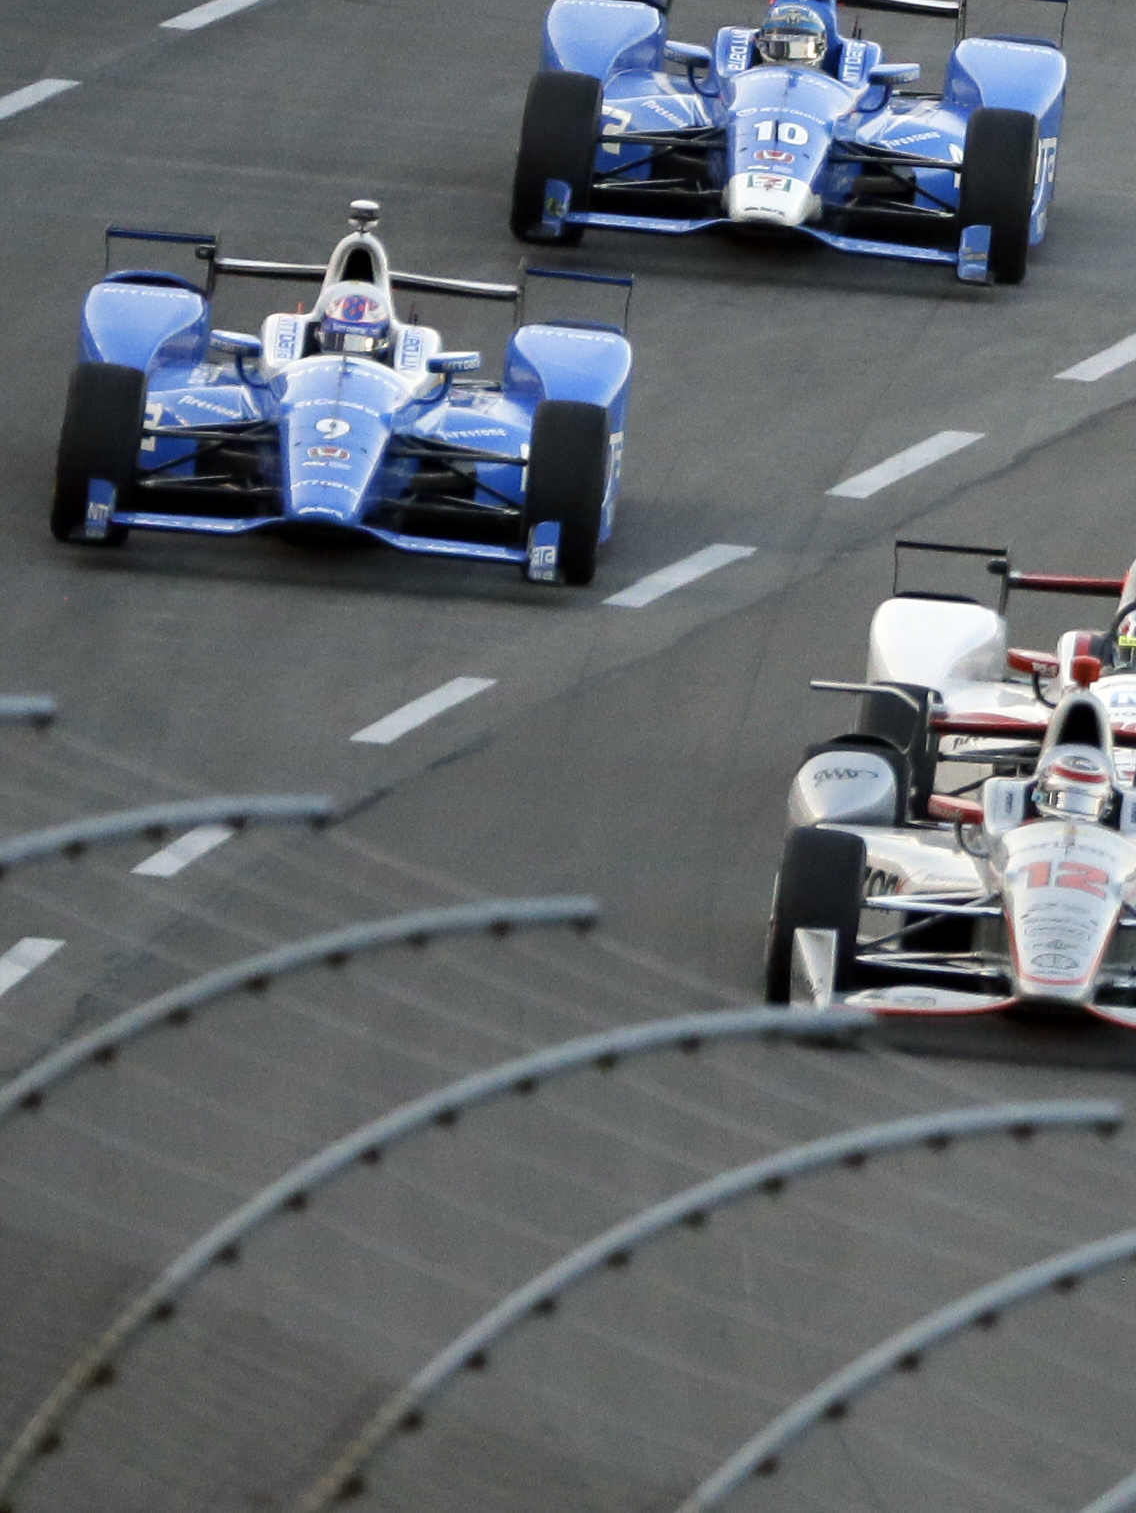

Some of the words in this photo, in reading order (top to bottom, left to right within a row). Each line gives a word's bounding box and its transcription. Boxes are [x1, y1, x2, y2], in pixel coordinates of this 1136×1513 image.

[753, 120, 809, 146] 10
[879, 130, 942, 150] Firestone
[315, 418, 352, 439] 9
[1019, 861, 1109, 901] 12
